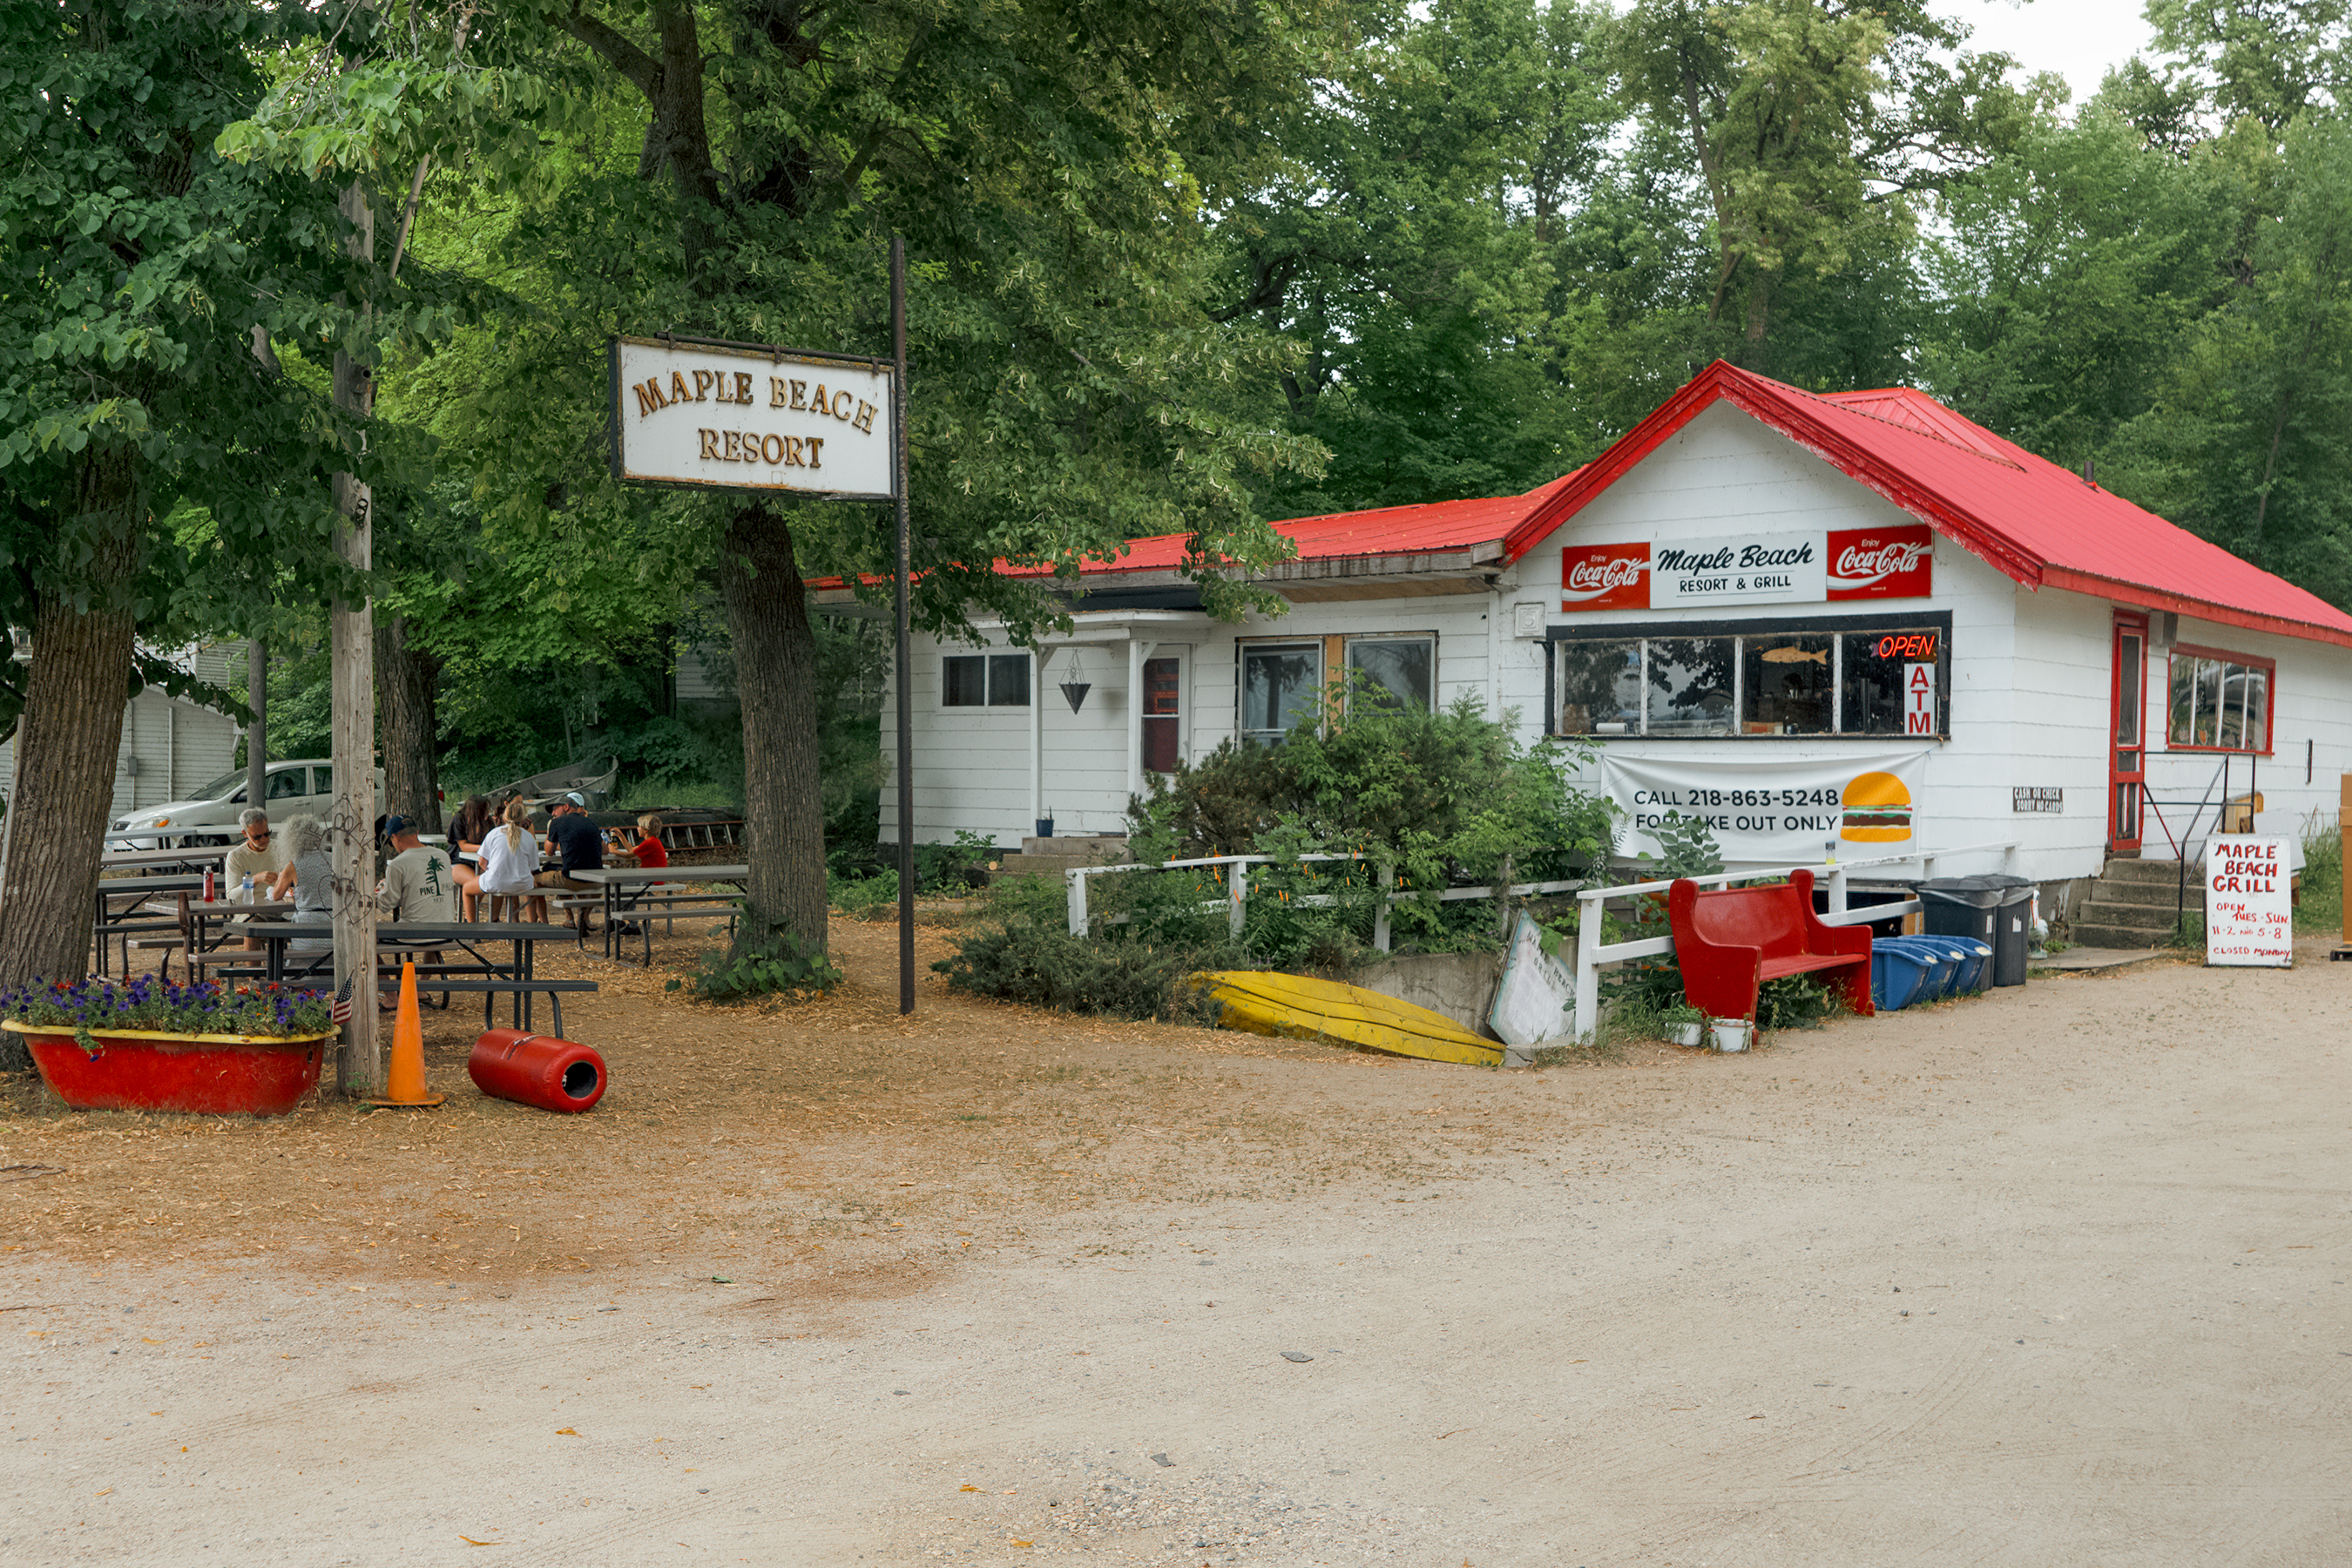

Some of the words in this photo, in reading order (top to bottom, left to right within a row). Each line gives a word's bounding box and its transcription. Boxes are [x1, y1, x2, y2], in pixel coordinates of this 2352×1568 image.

[633, 369, 753, 417] MAPLE
[769, 375, 878, 435] BEACH
[698, 428, 824, 468] RESORT
[1862, 538, 1880, 548] Enjoy
[1591, 554, 1607, 563] Enjoy
[1657, 546, 1734, 577] Maple
[1738, 541, 1815, 568] Beach
[1836, 541, 1923, 576] Coca-Cola
[1570, 558, 1642, 589] Coca-Cola
[1680, 578, 1728, 592] RESORT
[1736, 578, 1746, 590] &
[1754, 576, 1791, 589] GRILL
[1878, 635, 1936, 658] OPEN
[1909, 666, 1930, 733] ATM
[1634, 791, 1682, 806] CALL
[1688, 789, 1839, 807] 218-863-5248
[1681, 815, 1729, 830] TKE
[1736, 815, 1776, 831] OUT
[1784, 815, 1838, 830] ONLY
[2215, 844, 2277, 859] MAPLE
[2225, 861, 2278, 877] BEACH
[419, 886, 435, 896] PINE
[2213, 875, 2275, 893] GRILL
[2216, 902, 2245, 912] OPEN
[2254, 948, 2291, 963] MONDAY
